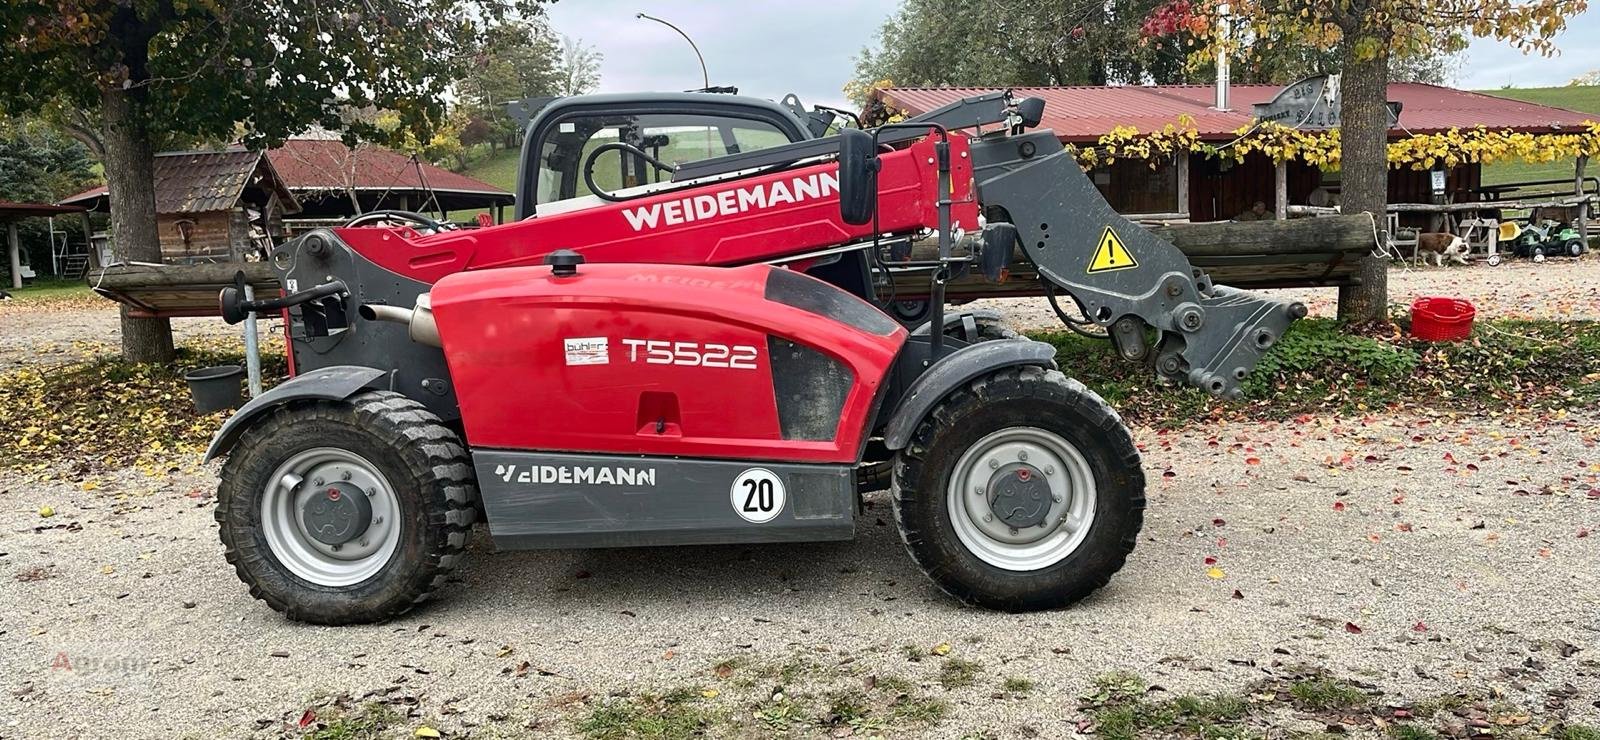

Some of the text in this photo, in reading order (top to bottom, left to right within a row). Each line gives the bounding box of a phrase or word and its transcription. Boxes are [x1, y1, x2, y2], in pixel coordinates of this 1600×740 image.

[622, 172, 839, 231] WEIDEMANN
[622, 338, 757, 369] T5522
[742, 478, 774, 512] 20
